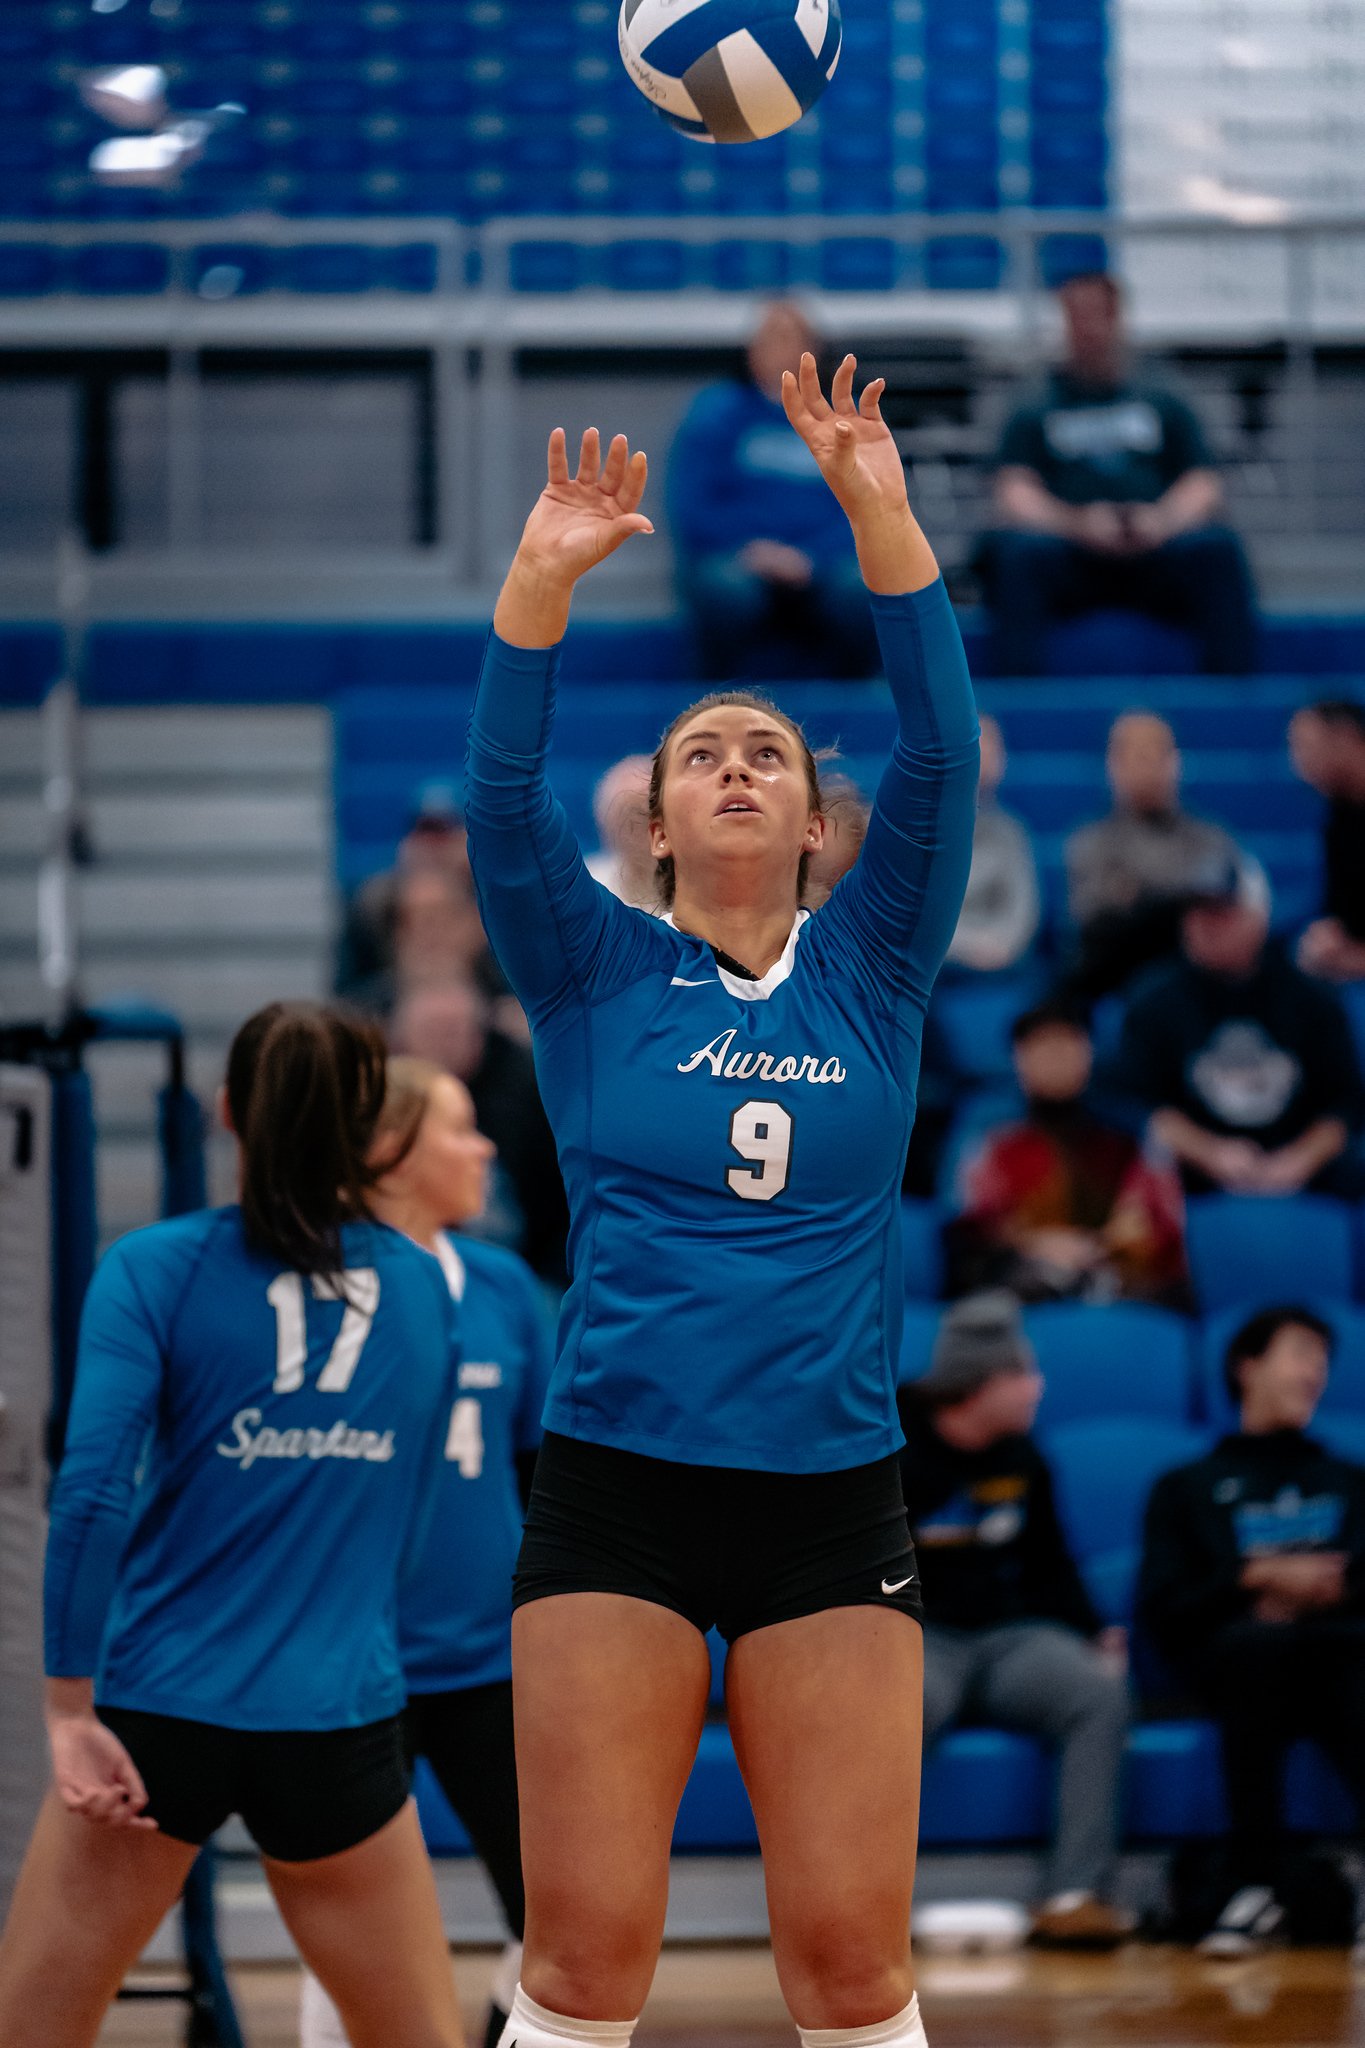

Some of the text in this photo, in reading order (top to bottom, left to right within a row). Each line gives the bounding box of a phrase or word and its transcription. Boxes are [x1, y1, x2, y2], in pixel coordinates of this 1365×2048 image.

[676, 1028, 847, 1084] Aurora
[726, 1099, 794, 1201] 9
[267, 1267, 380, 1394] 17
[444, 1397, 485, 1480] 4
